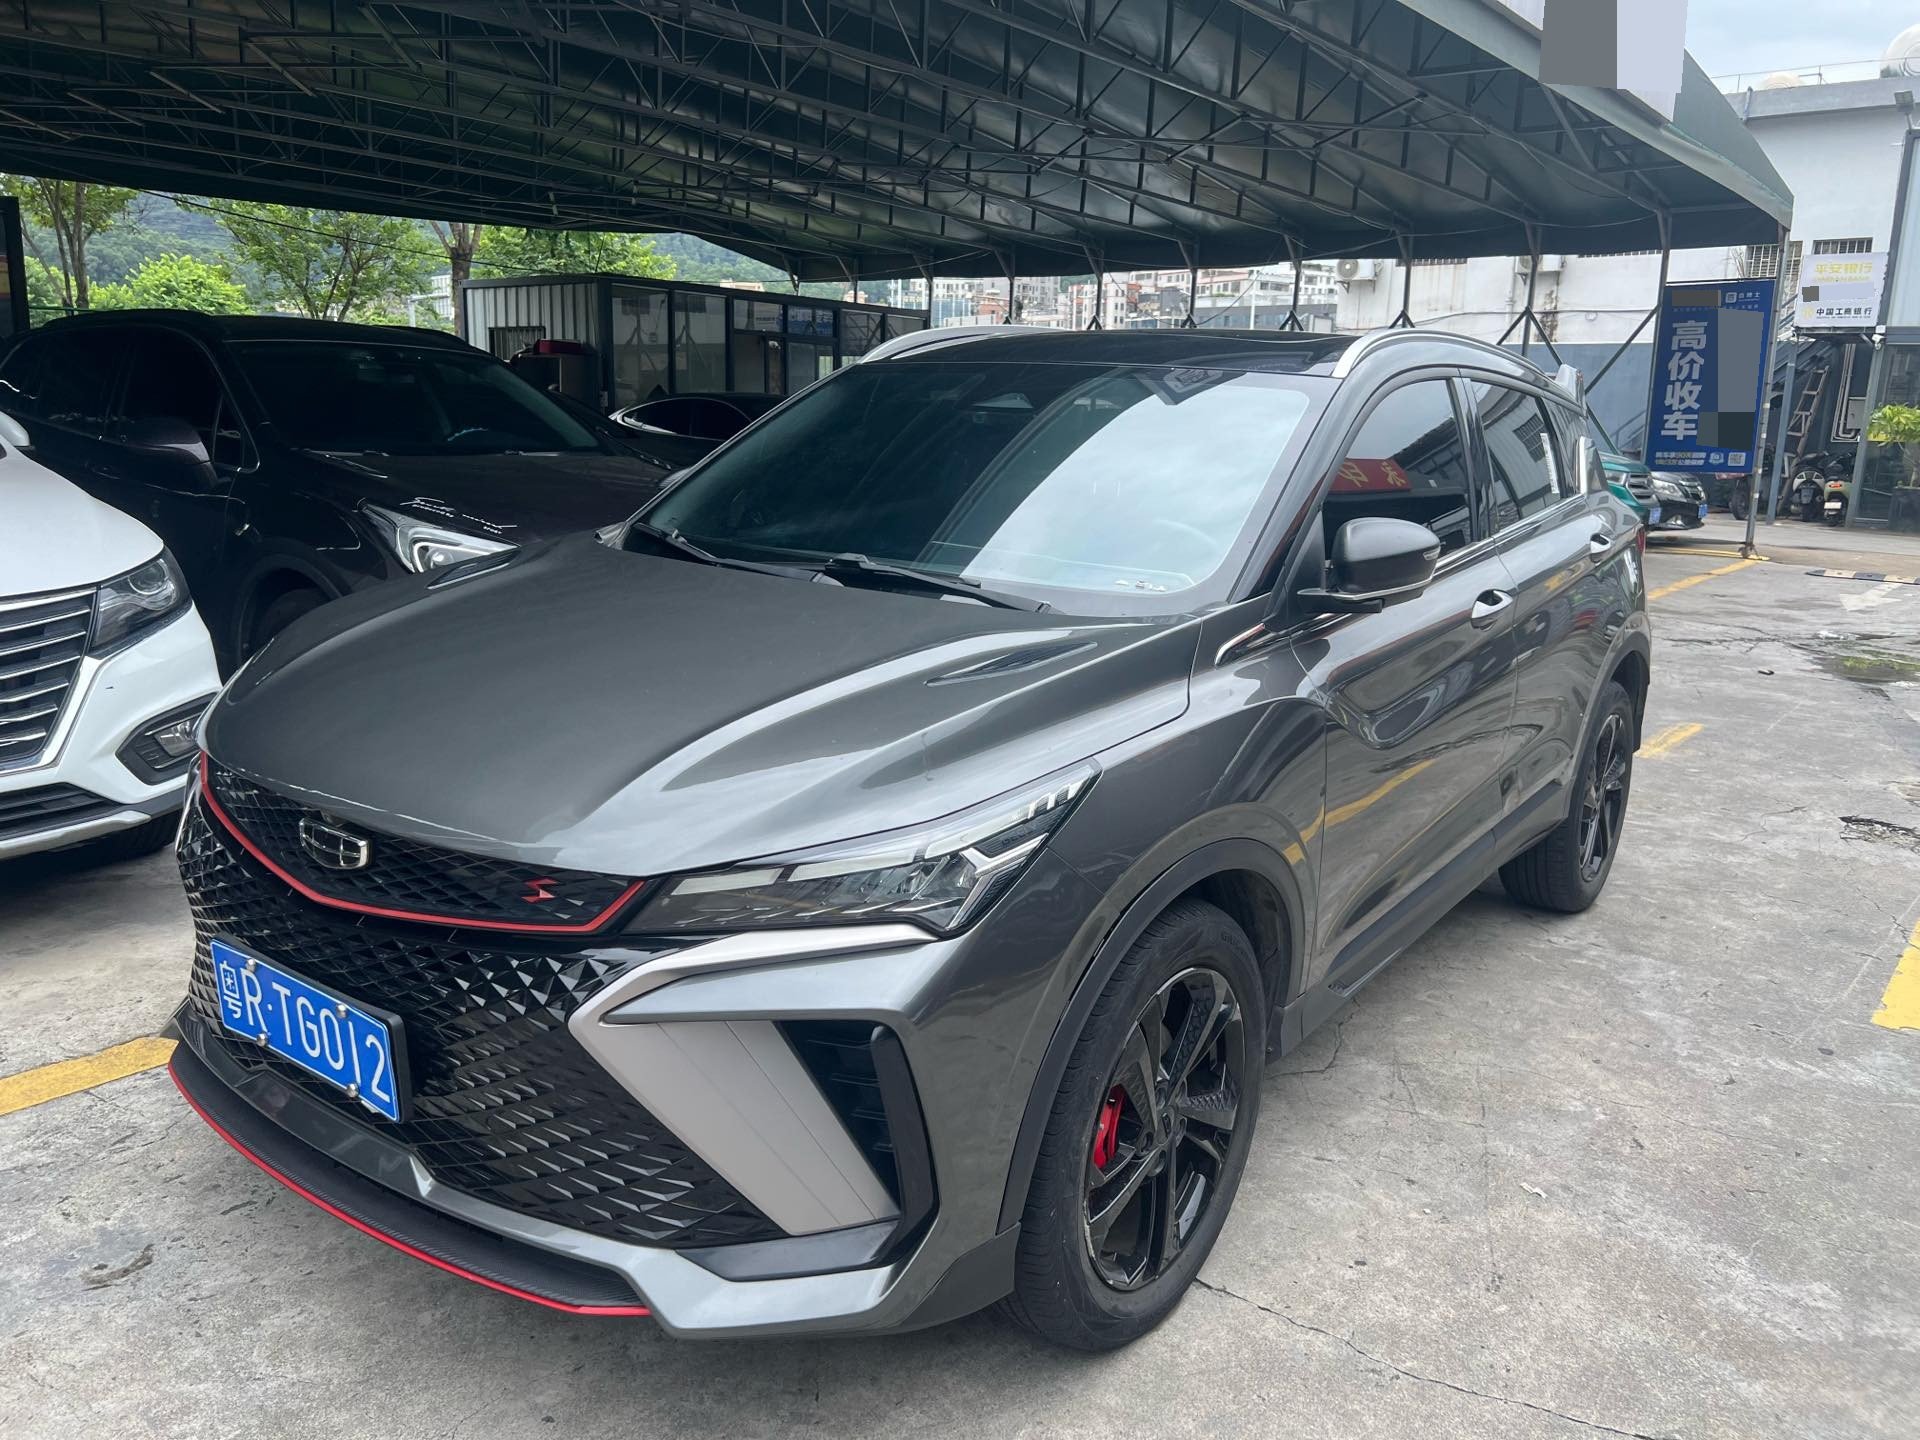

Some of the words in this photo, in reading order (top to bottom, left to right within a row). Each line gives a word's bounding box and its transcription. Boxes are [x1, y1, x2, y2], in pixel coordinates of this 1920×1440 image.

[1815, 263, 1872, 273] 平安银行
[1816, 307, 1872, 316] 中国工商银行
[1661, 320, 1708, 440] 高价收车
